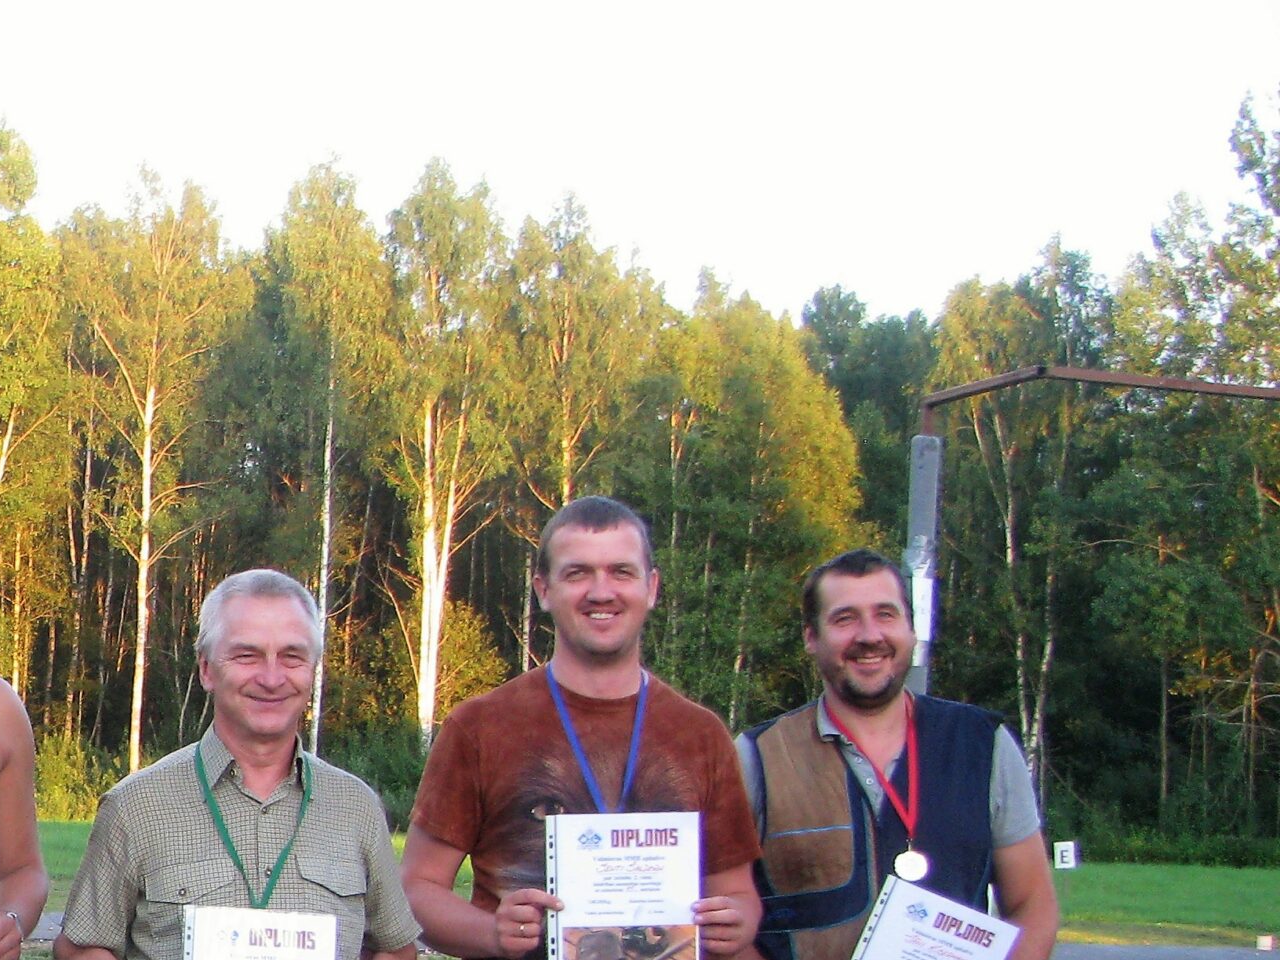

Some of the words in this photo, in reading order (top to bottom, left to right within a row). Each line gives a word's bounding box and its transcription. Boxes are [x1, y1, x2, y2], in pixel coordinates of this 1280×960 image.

[610, 828, 678, 848] DIPLOMS
[1060, 849, 1070, 864] E
[932, 912, 996, 948] DIPLOMS
